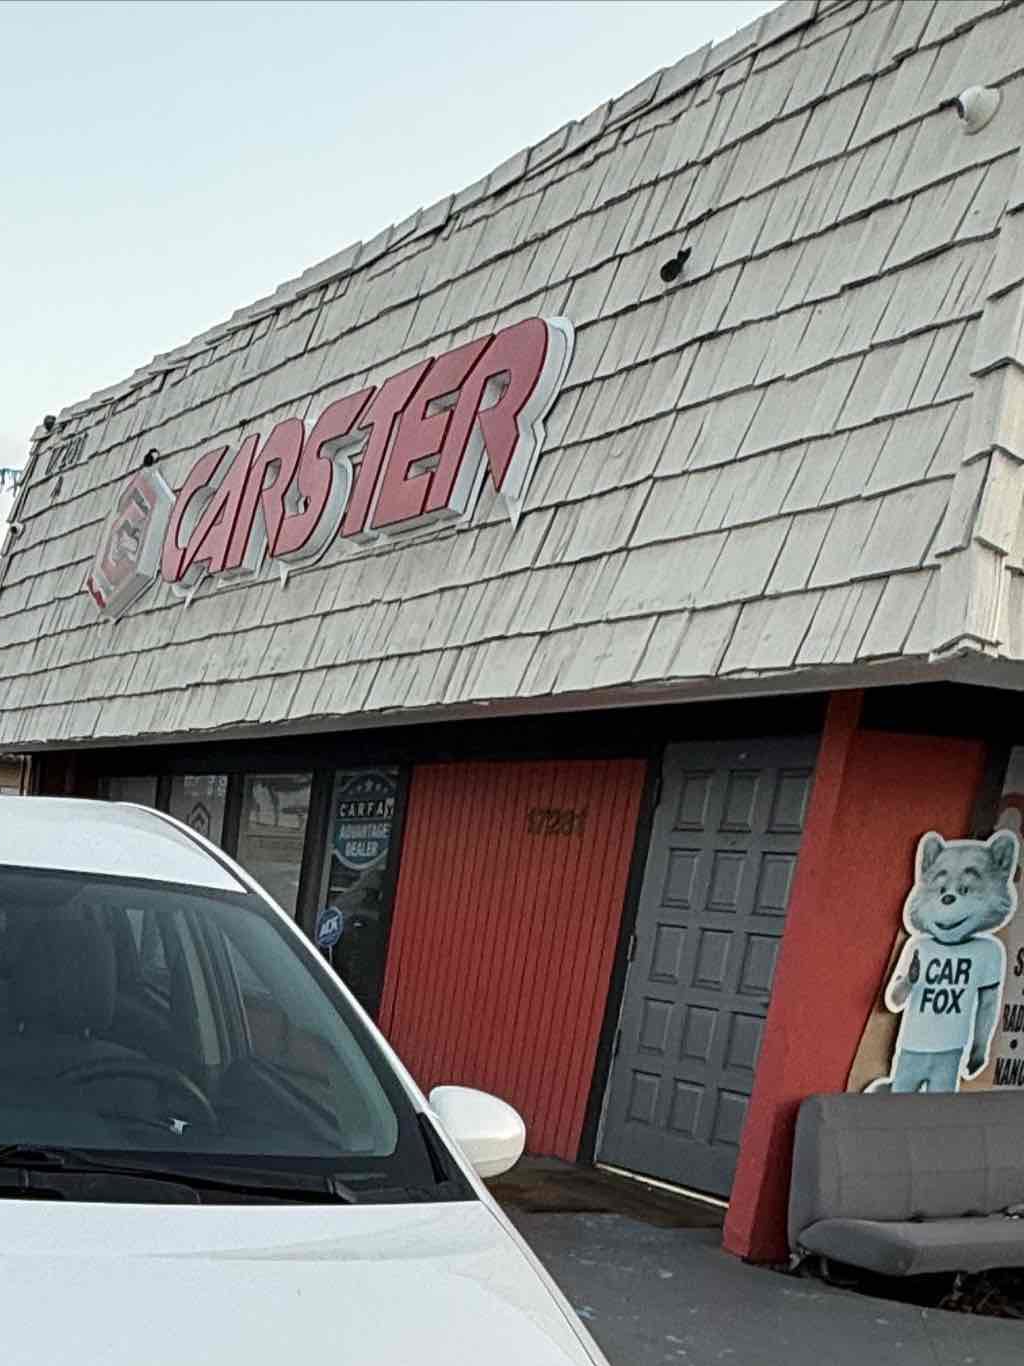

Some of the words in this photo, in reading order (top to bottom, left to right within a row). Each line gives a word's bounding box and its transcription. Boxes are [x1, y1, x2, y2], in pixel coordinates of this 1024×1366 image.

[160, 317, 549, 584] CARSTER
[926, 957, 972, 985] CAR
[920, 988, 965, 1014] FOX
